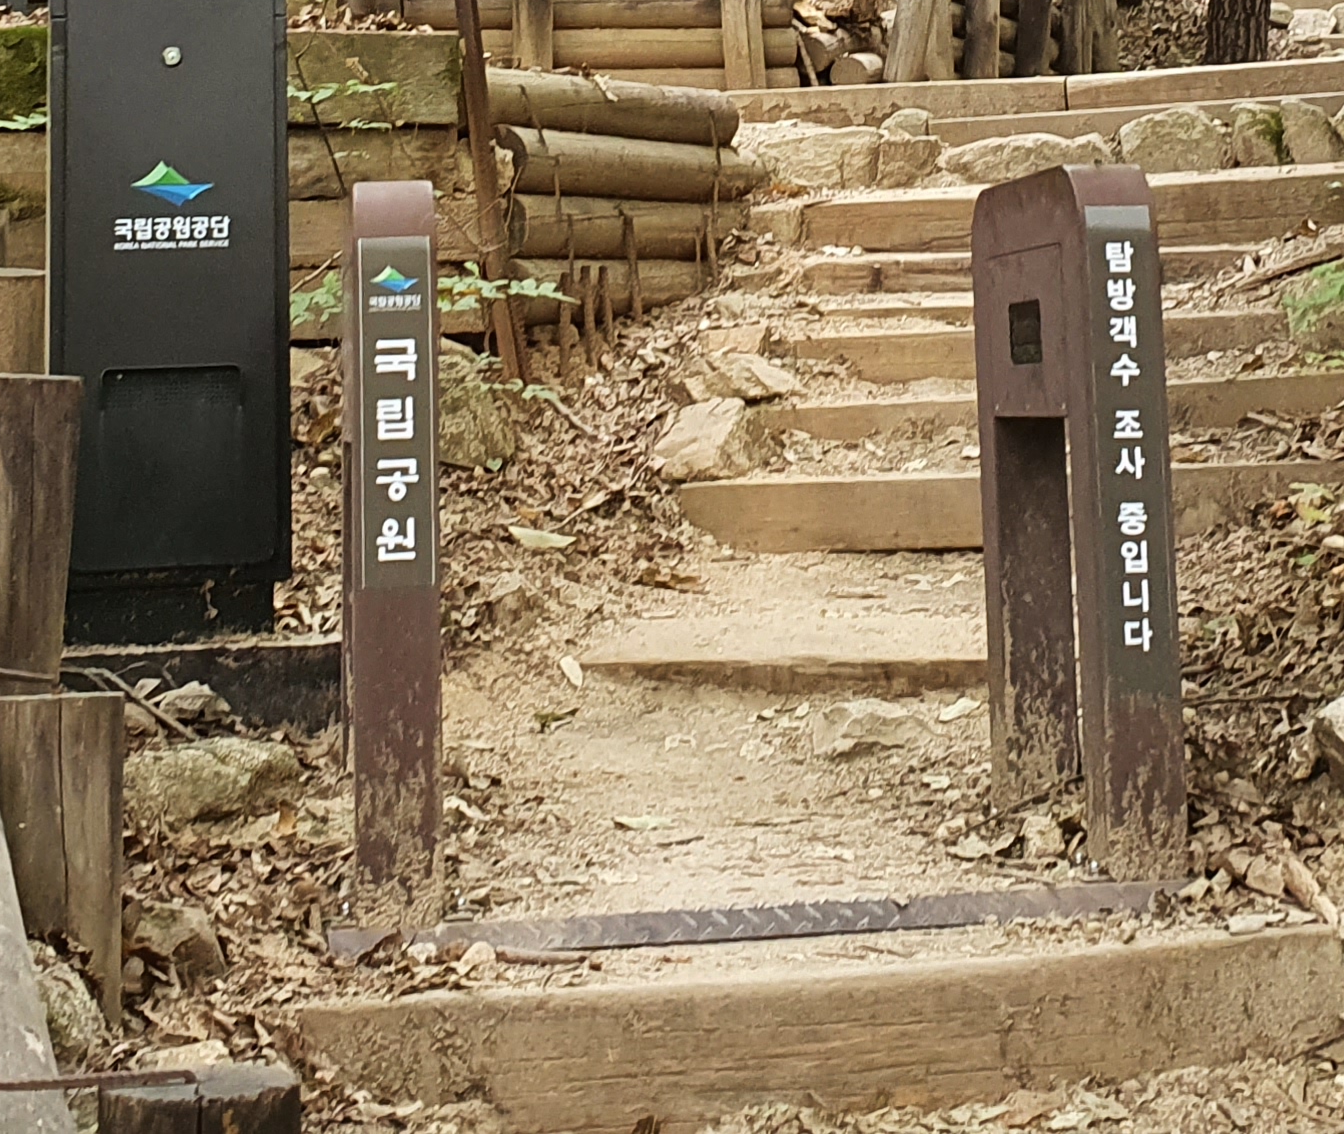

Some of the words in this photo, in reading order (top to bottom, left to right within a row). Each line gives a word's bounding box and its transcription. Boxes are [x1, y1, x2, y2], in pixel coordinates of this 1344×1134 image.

[113, 215, 231, 241] 국립공원공단
[1104, 241, 1141, 387] 탐방객수
[374, 338, 419, 562] 국립공원
[1113, 409, 1146, 480] 조사
[1117, 502, 1153, 652] 중입니다
